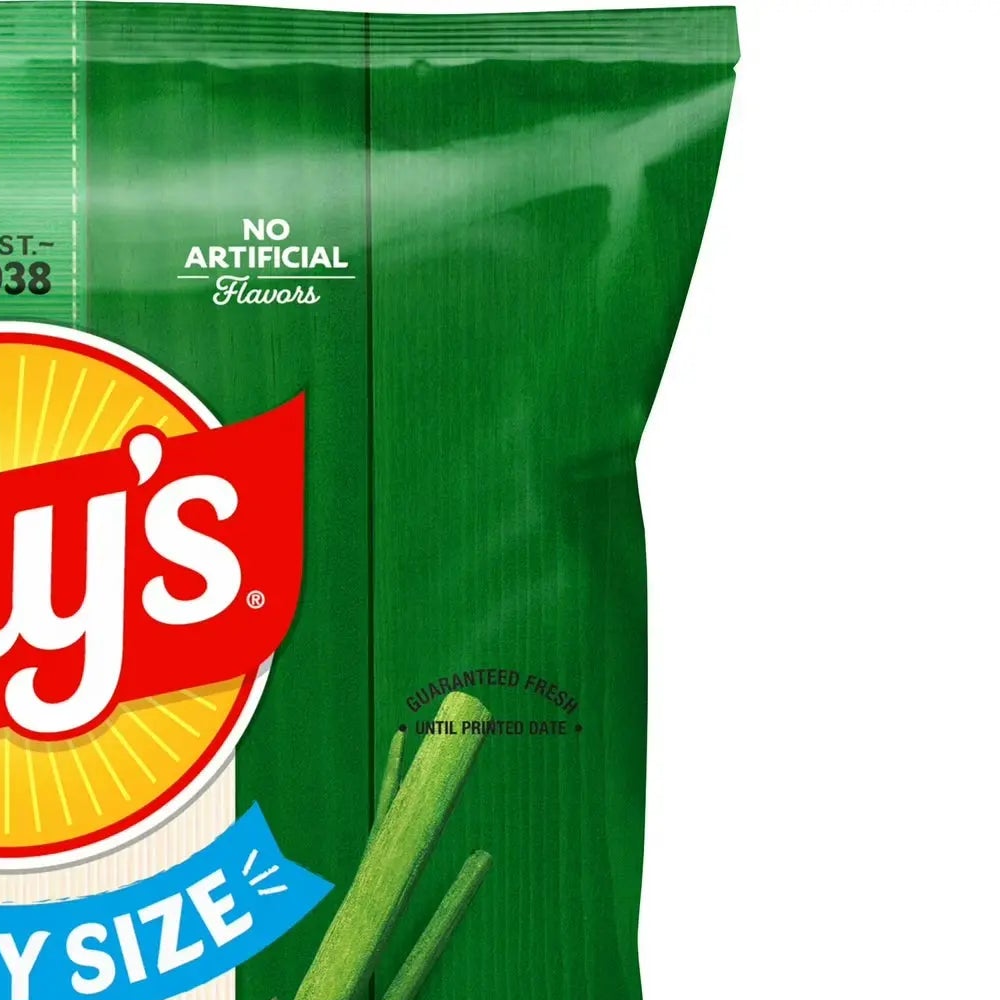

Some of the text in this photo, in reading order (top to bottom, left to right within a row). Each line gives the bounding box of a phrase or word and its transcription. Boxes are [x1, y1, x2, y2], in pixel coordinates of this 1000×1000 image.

[242, 218, 291, 242] NO
[184, 245, 350, 269] ARTIFICIAL
[213, 275, 321, 306] Flavors
[405, 668, 580, 716] GUARANTEED FRESH
[415, 720, 568, 736] UNTIL PRINTED DATE
[65, 868, 254, 997] SIZE
